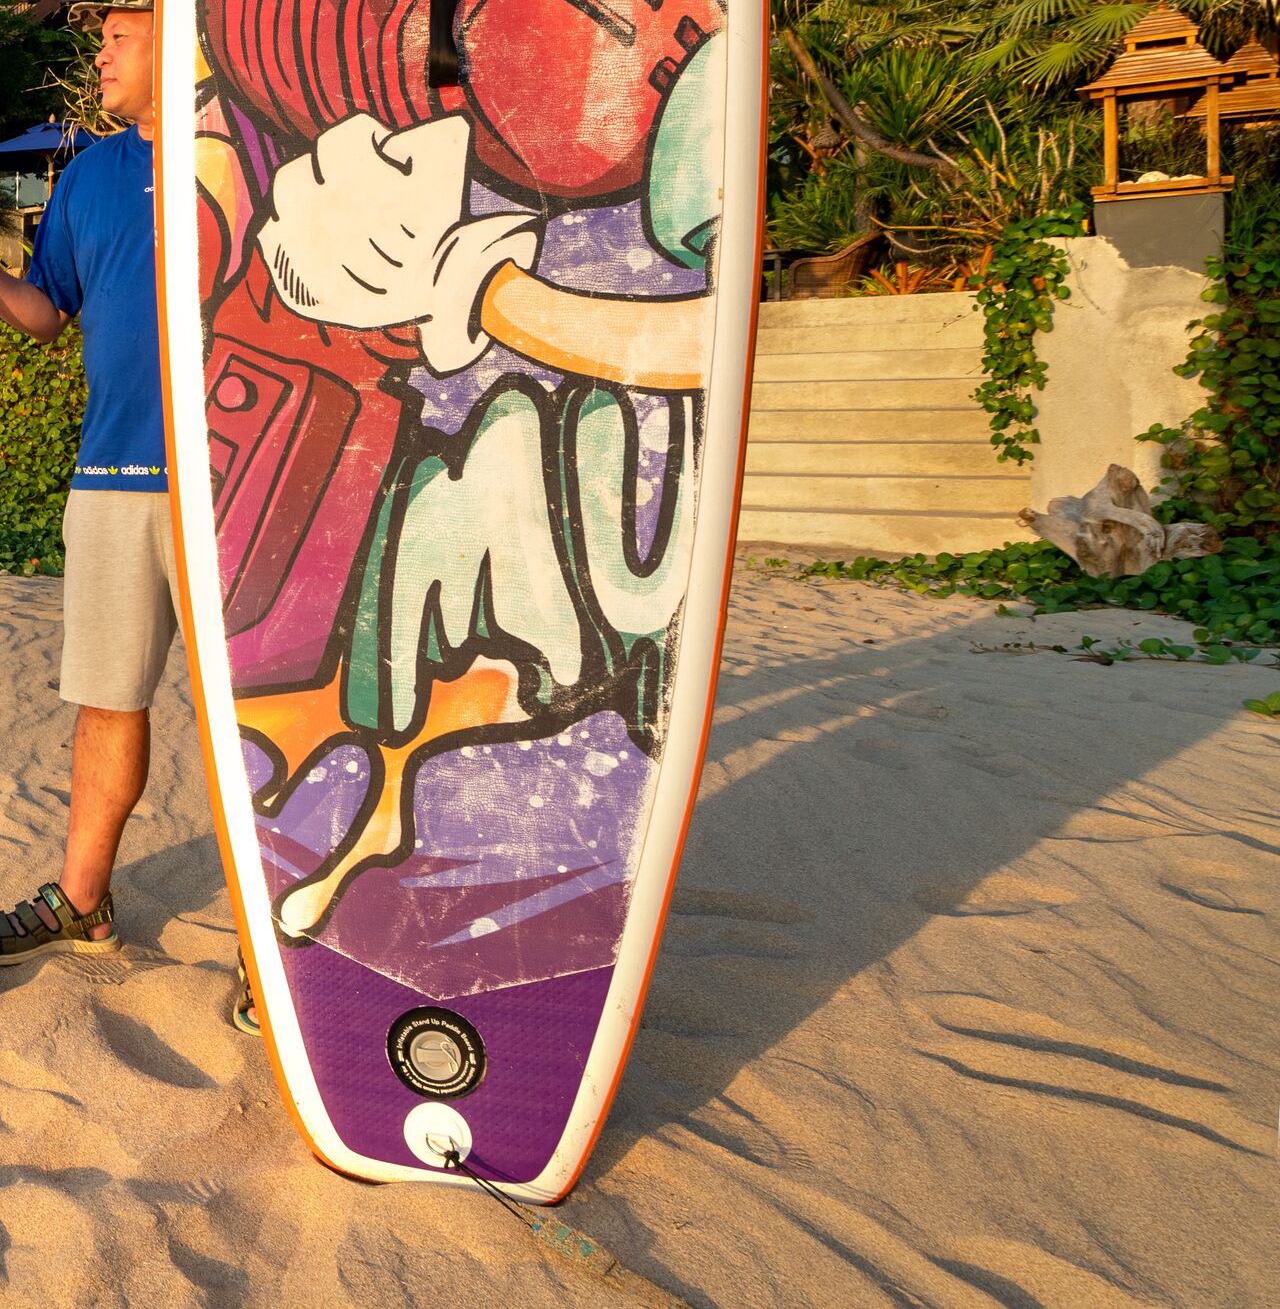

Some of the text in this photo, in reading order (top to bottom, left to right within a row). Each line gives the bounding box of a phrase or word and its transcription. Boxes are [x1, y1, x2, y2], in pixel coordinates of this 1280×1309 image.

[121, 465, 149, 475] adidas
[411, 1018, 430, 1028] Stand
[431, 1018, 440, 1026] Up
[460, 1033, 474, 1051] Board
